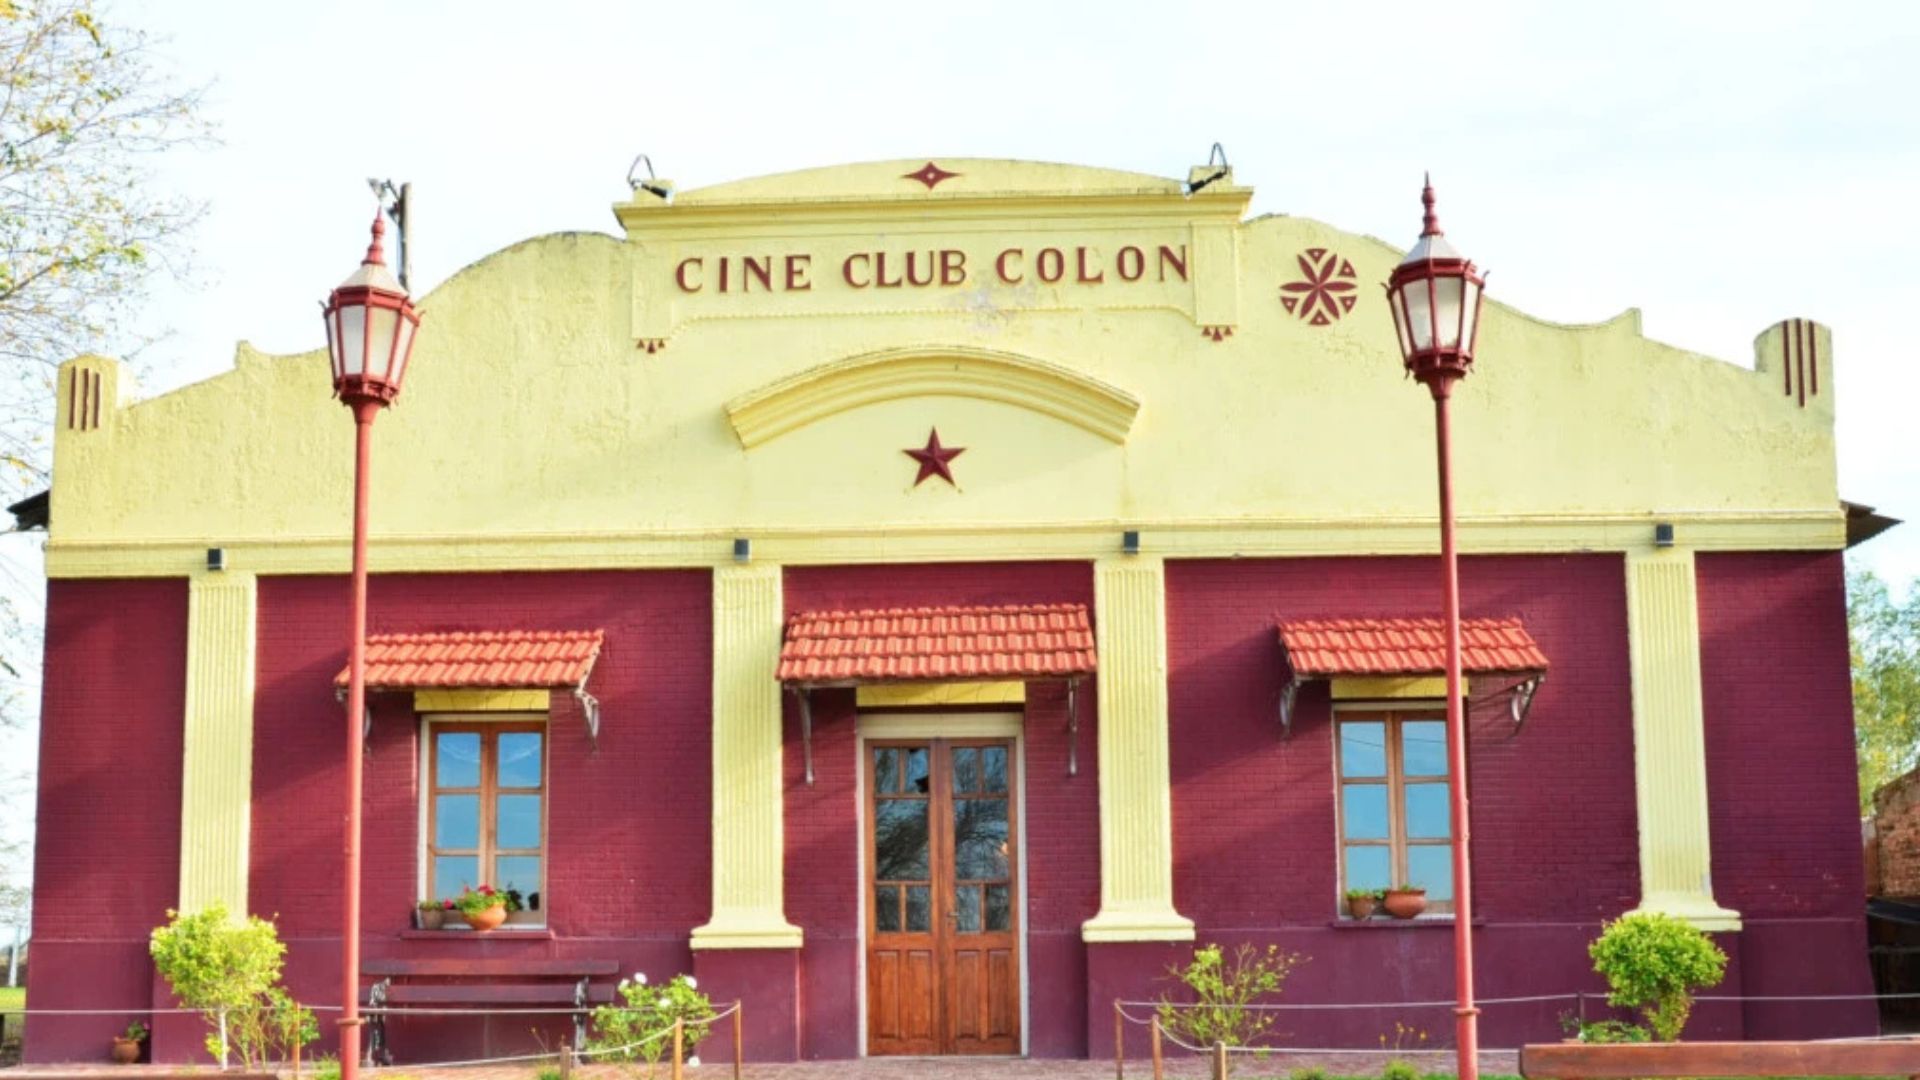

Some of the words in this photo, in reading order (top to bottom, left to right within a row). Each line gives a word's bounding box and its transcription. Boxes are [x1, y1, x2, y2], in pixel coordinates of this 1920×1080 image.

[676, 256, 812, 292] CINE
[844, 251, 967, 288] CLUB
[997, 246, 1188, 283] COLON
